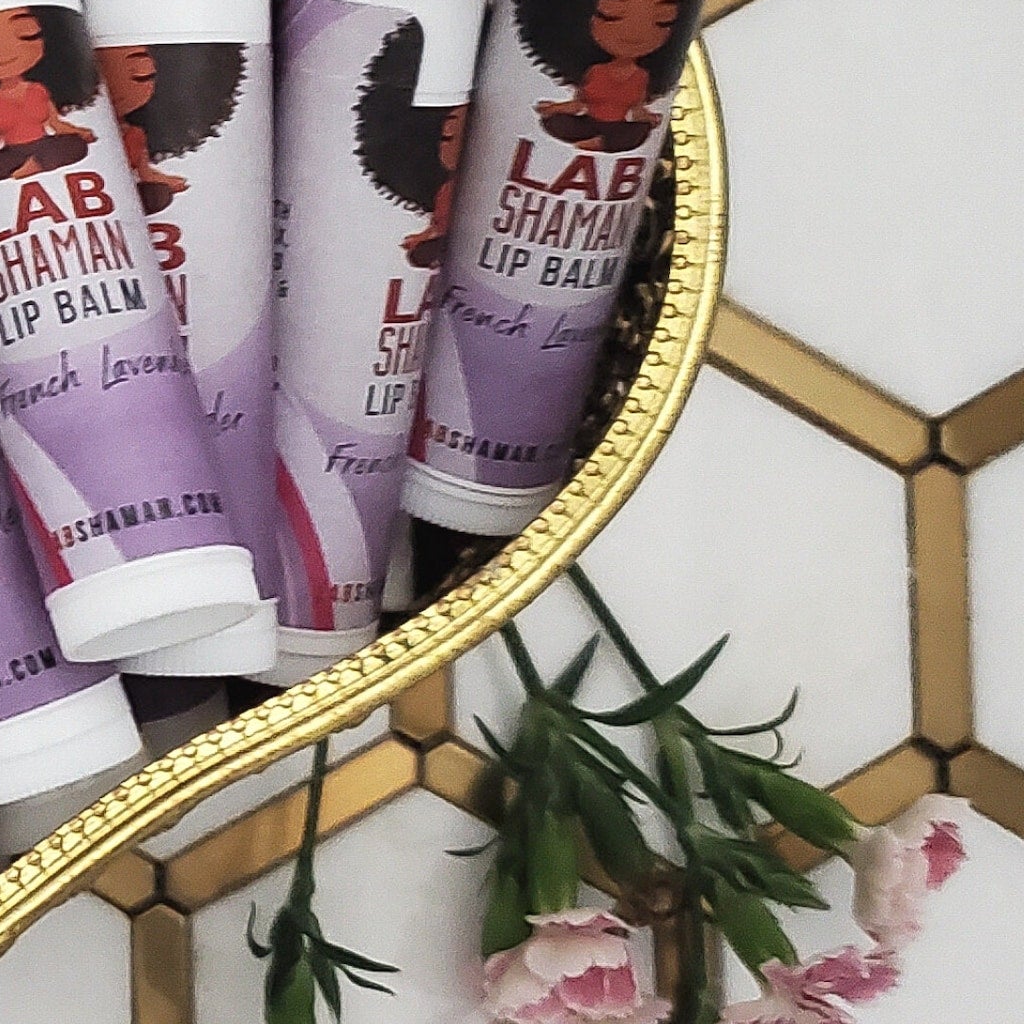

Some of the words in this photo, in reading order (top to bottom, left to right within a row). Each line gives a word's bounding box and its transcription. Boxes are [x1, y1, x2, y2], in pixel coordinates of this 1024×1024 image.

[507, 138, 646, 201] LAB
[478, 237, 531, 277] LIP
[54, 278, 147, 325] BALM
[365, 383, 406, 416] LIP
